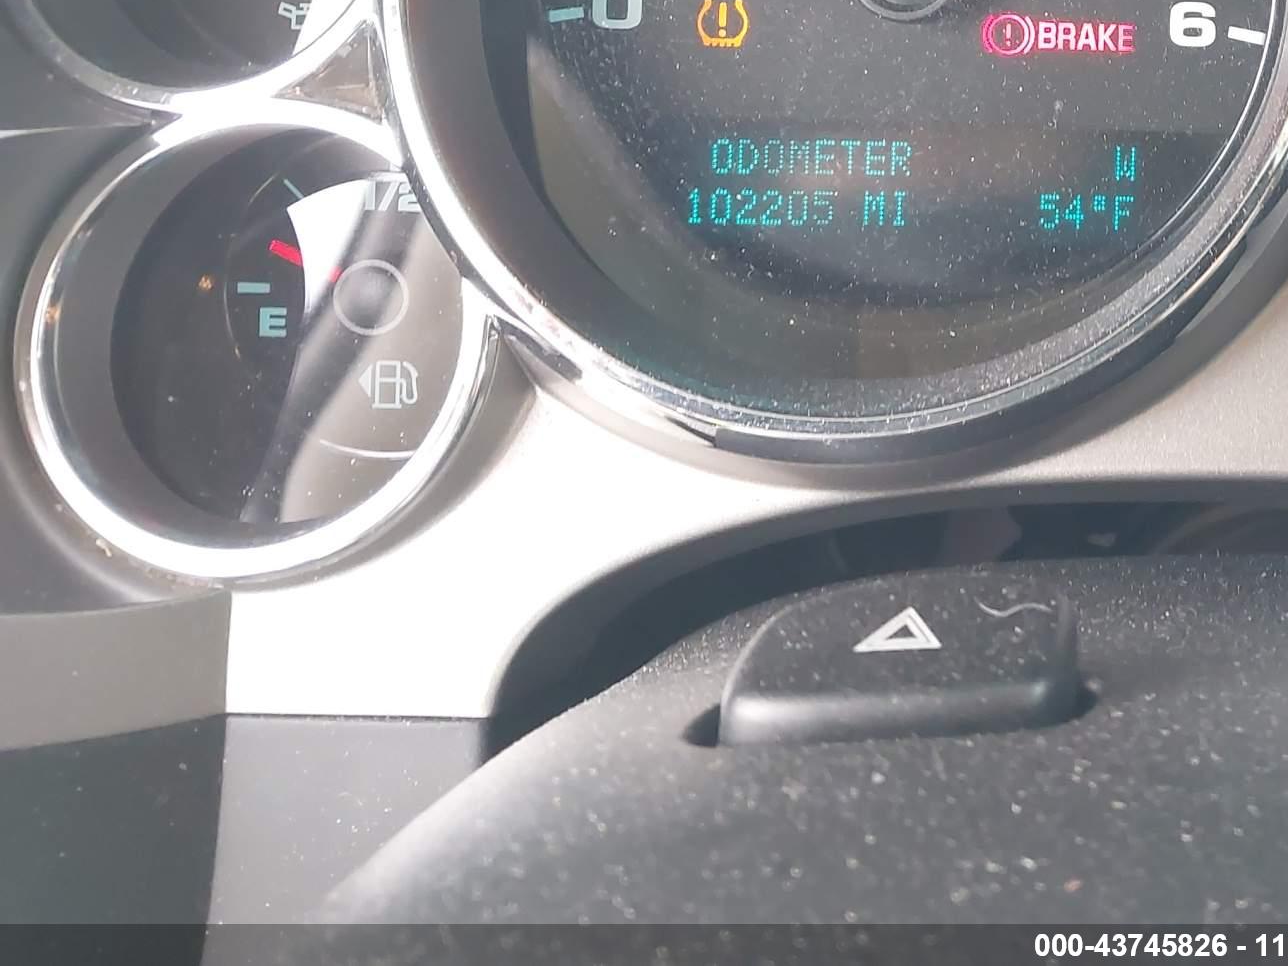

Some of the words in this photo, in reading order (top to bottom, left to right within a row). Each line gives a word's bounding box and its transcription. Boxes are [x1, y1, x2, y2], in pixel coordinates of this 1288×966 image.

[1037, 22, 1136, 52] BRAKE
[1169, 1, 1217, 47] 6
[710, 138, 912, 176] ODOMETER
[1114, 145, 1137, 181] W
[688, 188, 834, 227] 102205
[863, 191, 907, 227] MI
[1039, 193, 1136, 230] 54°F
[259, 306, 287, 337] E
